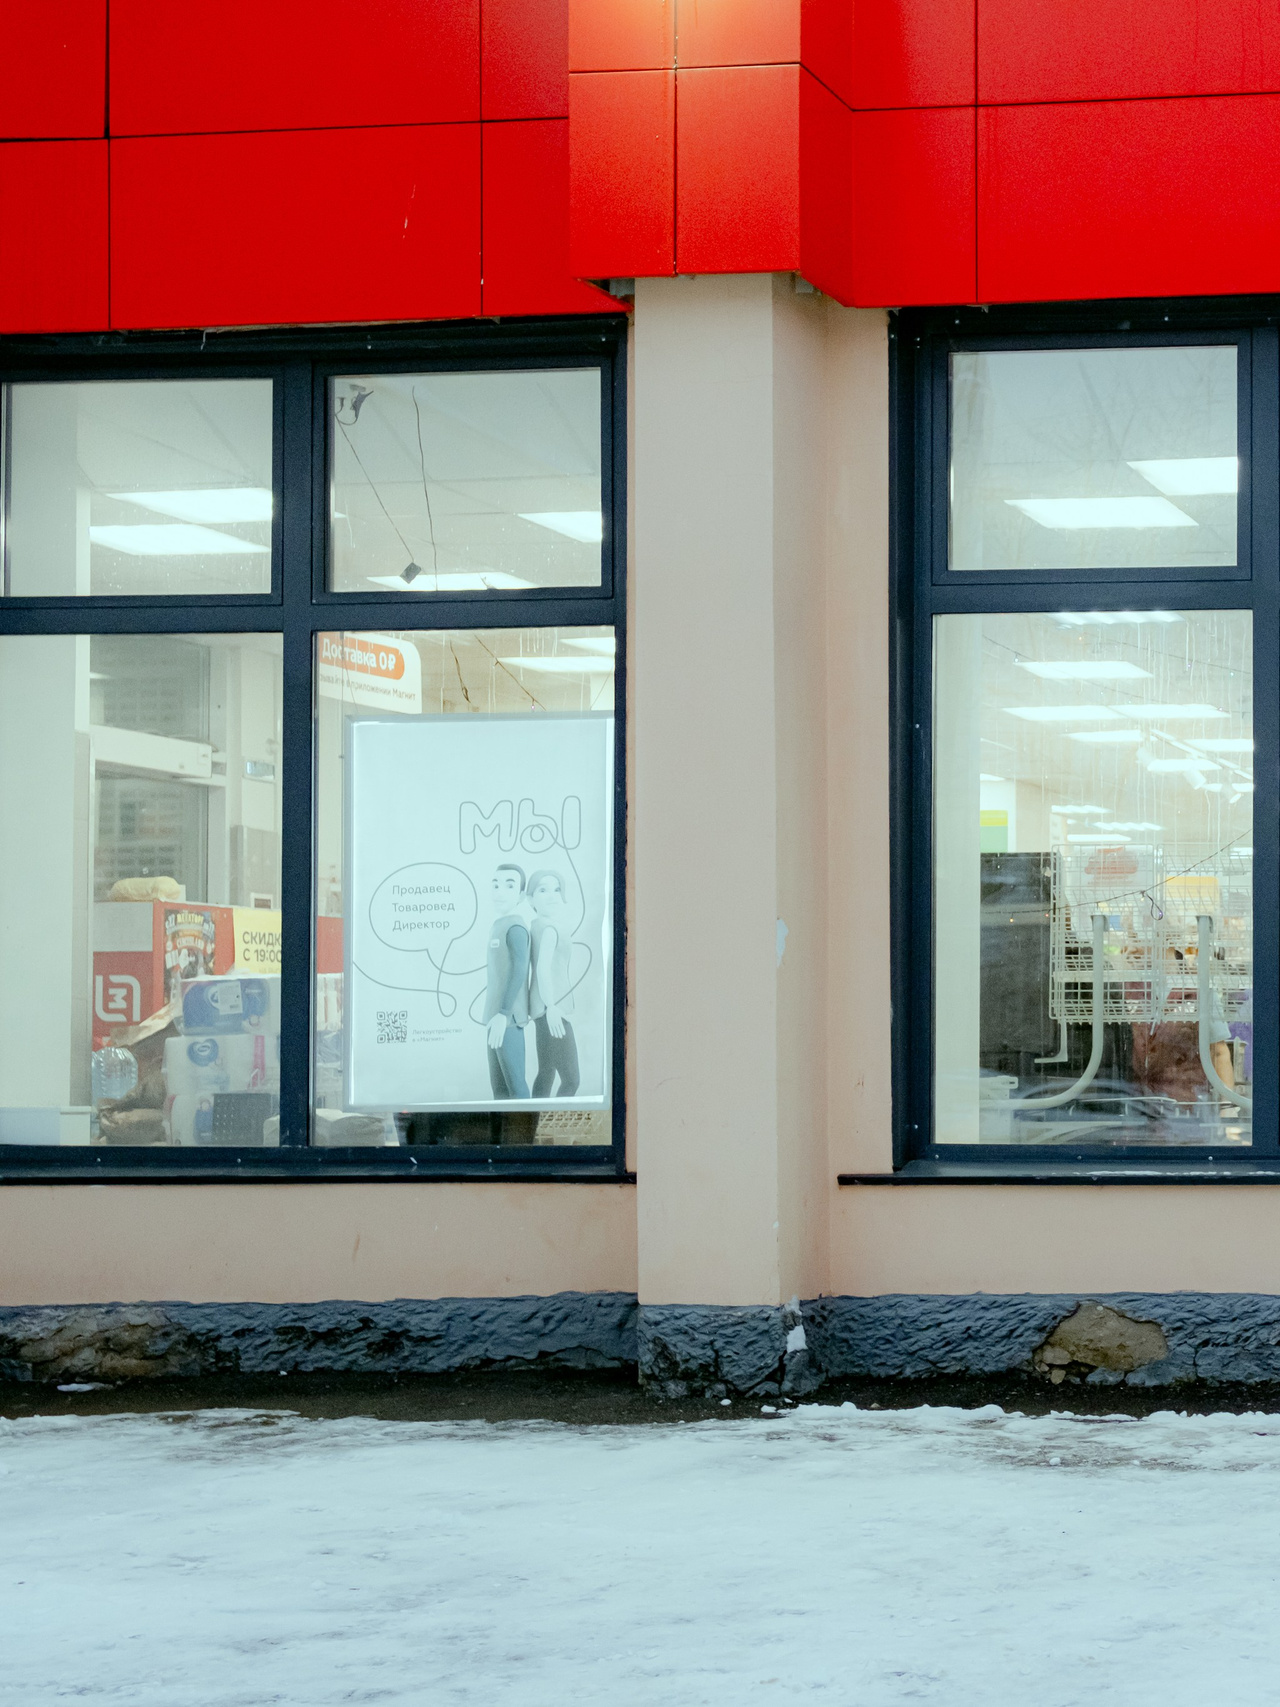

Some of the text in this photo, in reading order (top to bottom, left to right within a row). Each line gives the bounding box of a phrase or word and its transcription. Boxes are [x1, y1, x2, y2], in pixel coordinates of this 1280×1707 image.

[322, 638, 377, 668] Доставка
[392, 687, 416, 701] Магнит
[392, 885, 451, 897] Продавец
[391, 902, 456, 914] Товаровед
[392, 920, 450, 932] Директор
[242, 931, 281, 946] СКИДК
[243, 948, 281, 963] С 19:00
